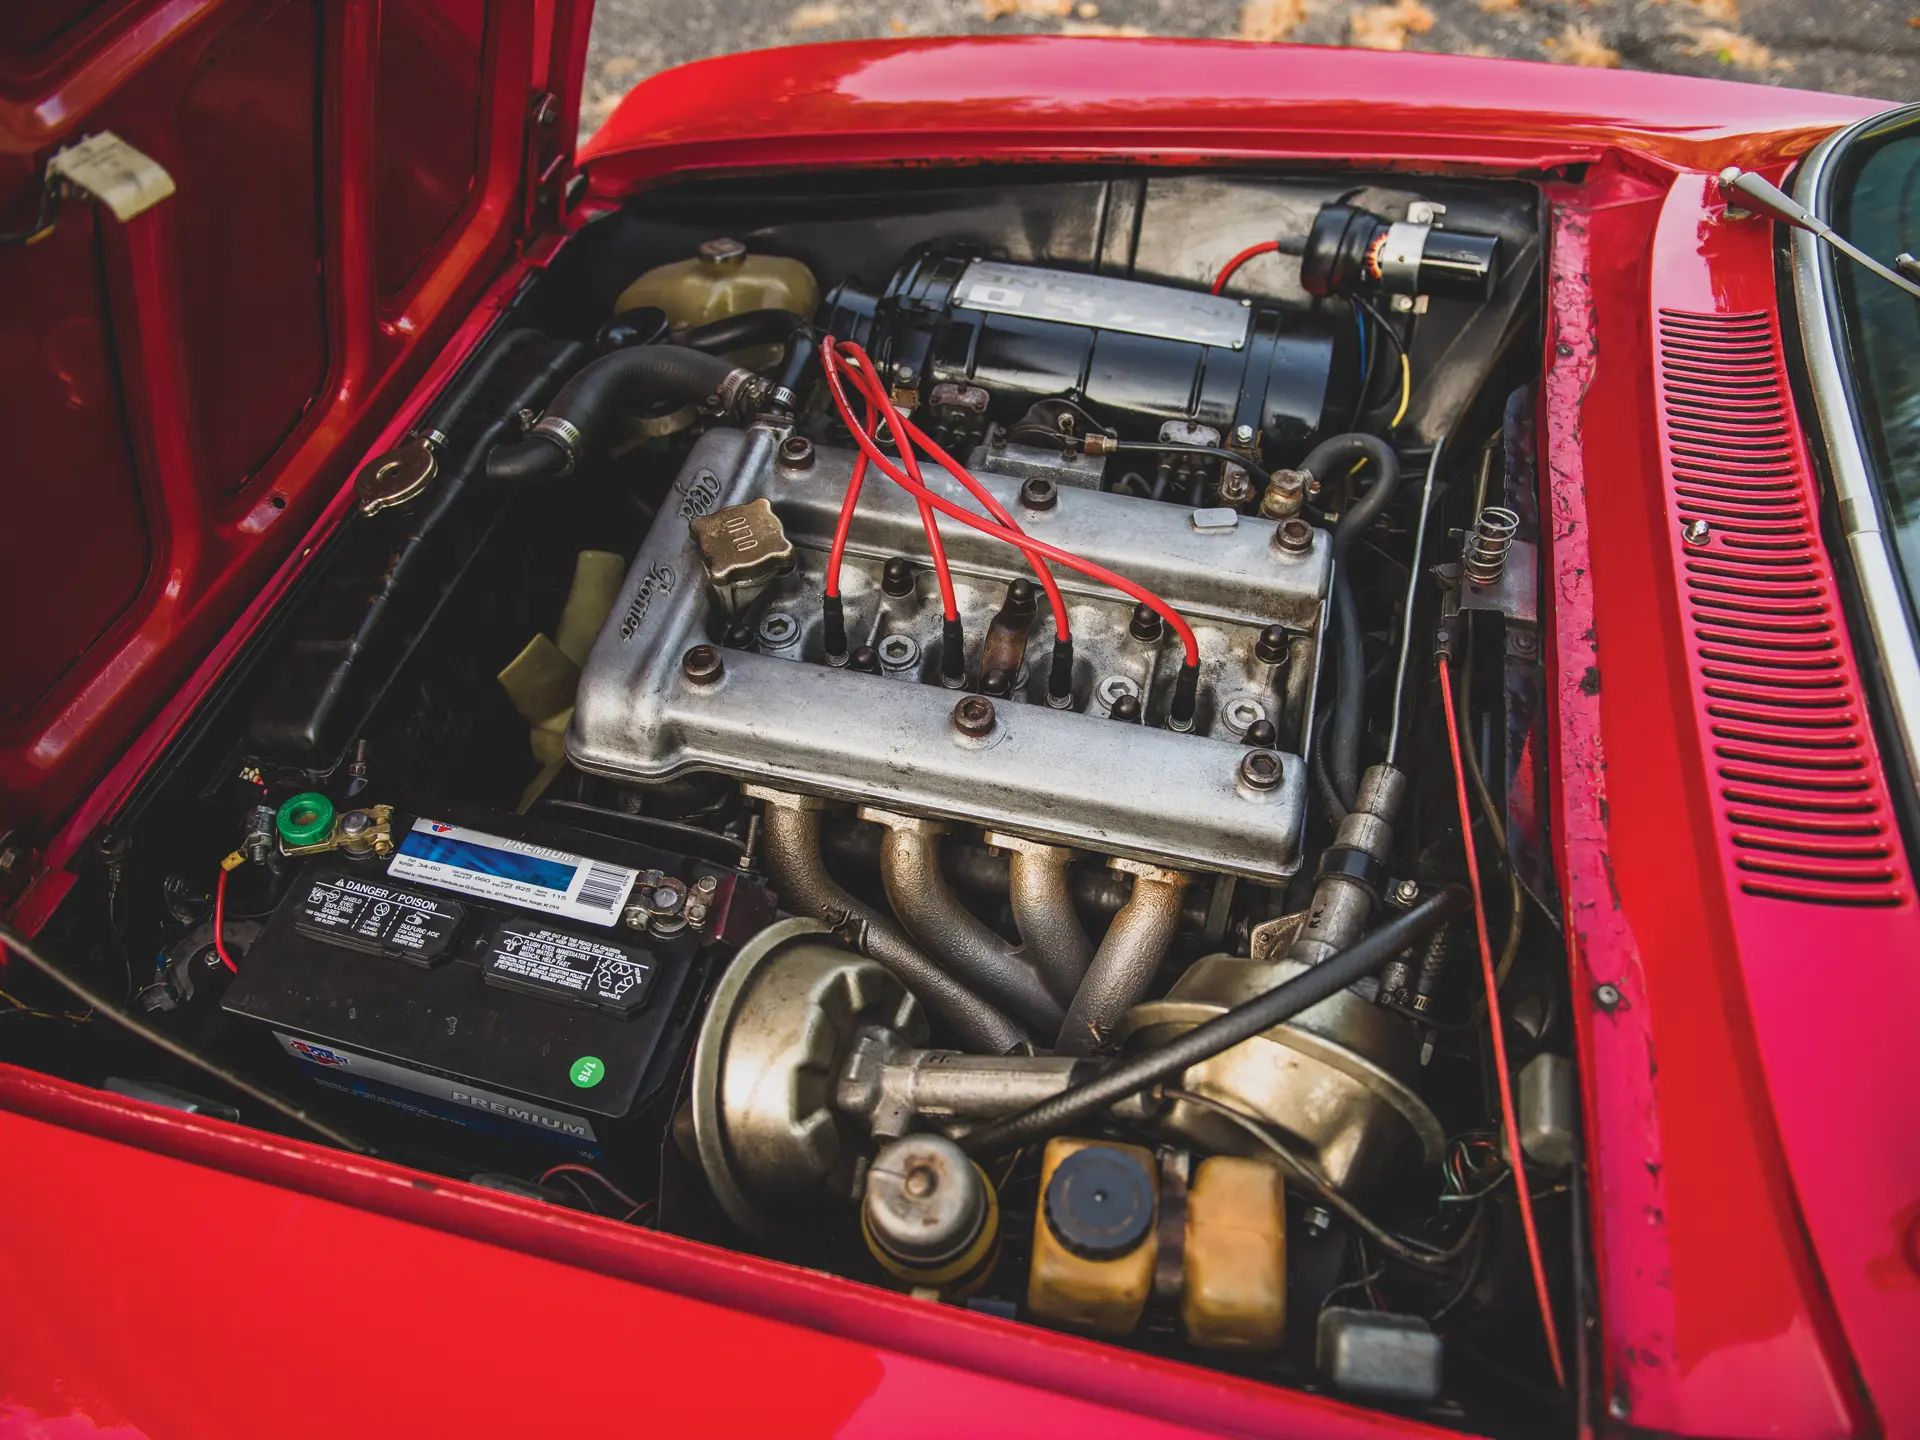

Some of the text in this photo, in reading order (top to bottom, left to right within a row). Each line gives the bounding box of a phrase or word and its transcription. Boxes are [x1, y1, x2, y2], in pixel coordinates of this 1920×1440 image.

[724, 516, 758, 552] OLIO
[620, 468, 721, 643] Alfa Romeo
[503, 840, 576, 862] PREMIUM
[418, 863, 441, 871] 34-60
[342, 895, 363, 904] SHIELD
[346, 881, 389, 899] DANGER
[398, 894, 438, 911] POISON
[325, 902, 354, 914] EXPLOSIVE
[340, 900, 354, 908] EYES
[322, 907, 340, 916] GASES
[400, 923, 427, 935] SULFURIC
[407, 931, 422, 939] CAUSE
[518, 951, 540, 960] MEDICAL
[524, 940, 591, 961] FLUSH EYES IMMEDIATELY
[599, 990, 621, 1000] RECYCLE
[577, 1062, 597, 1083] 1/15
[452, 1090, 585, 1136] PREMIUM
